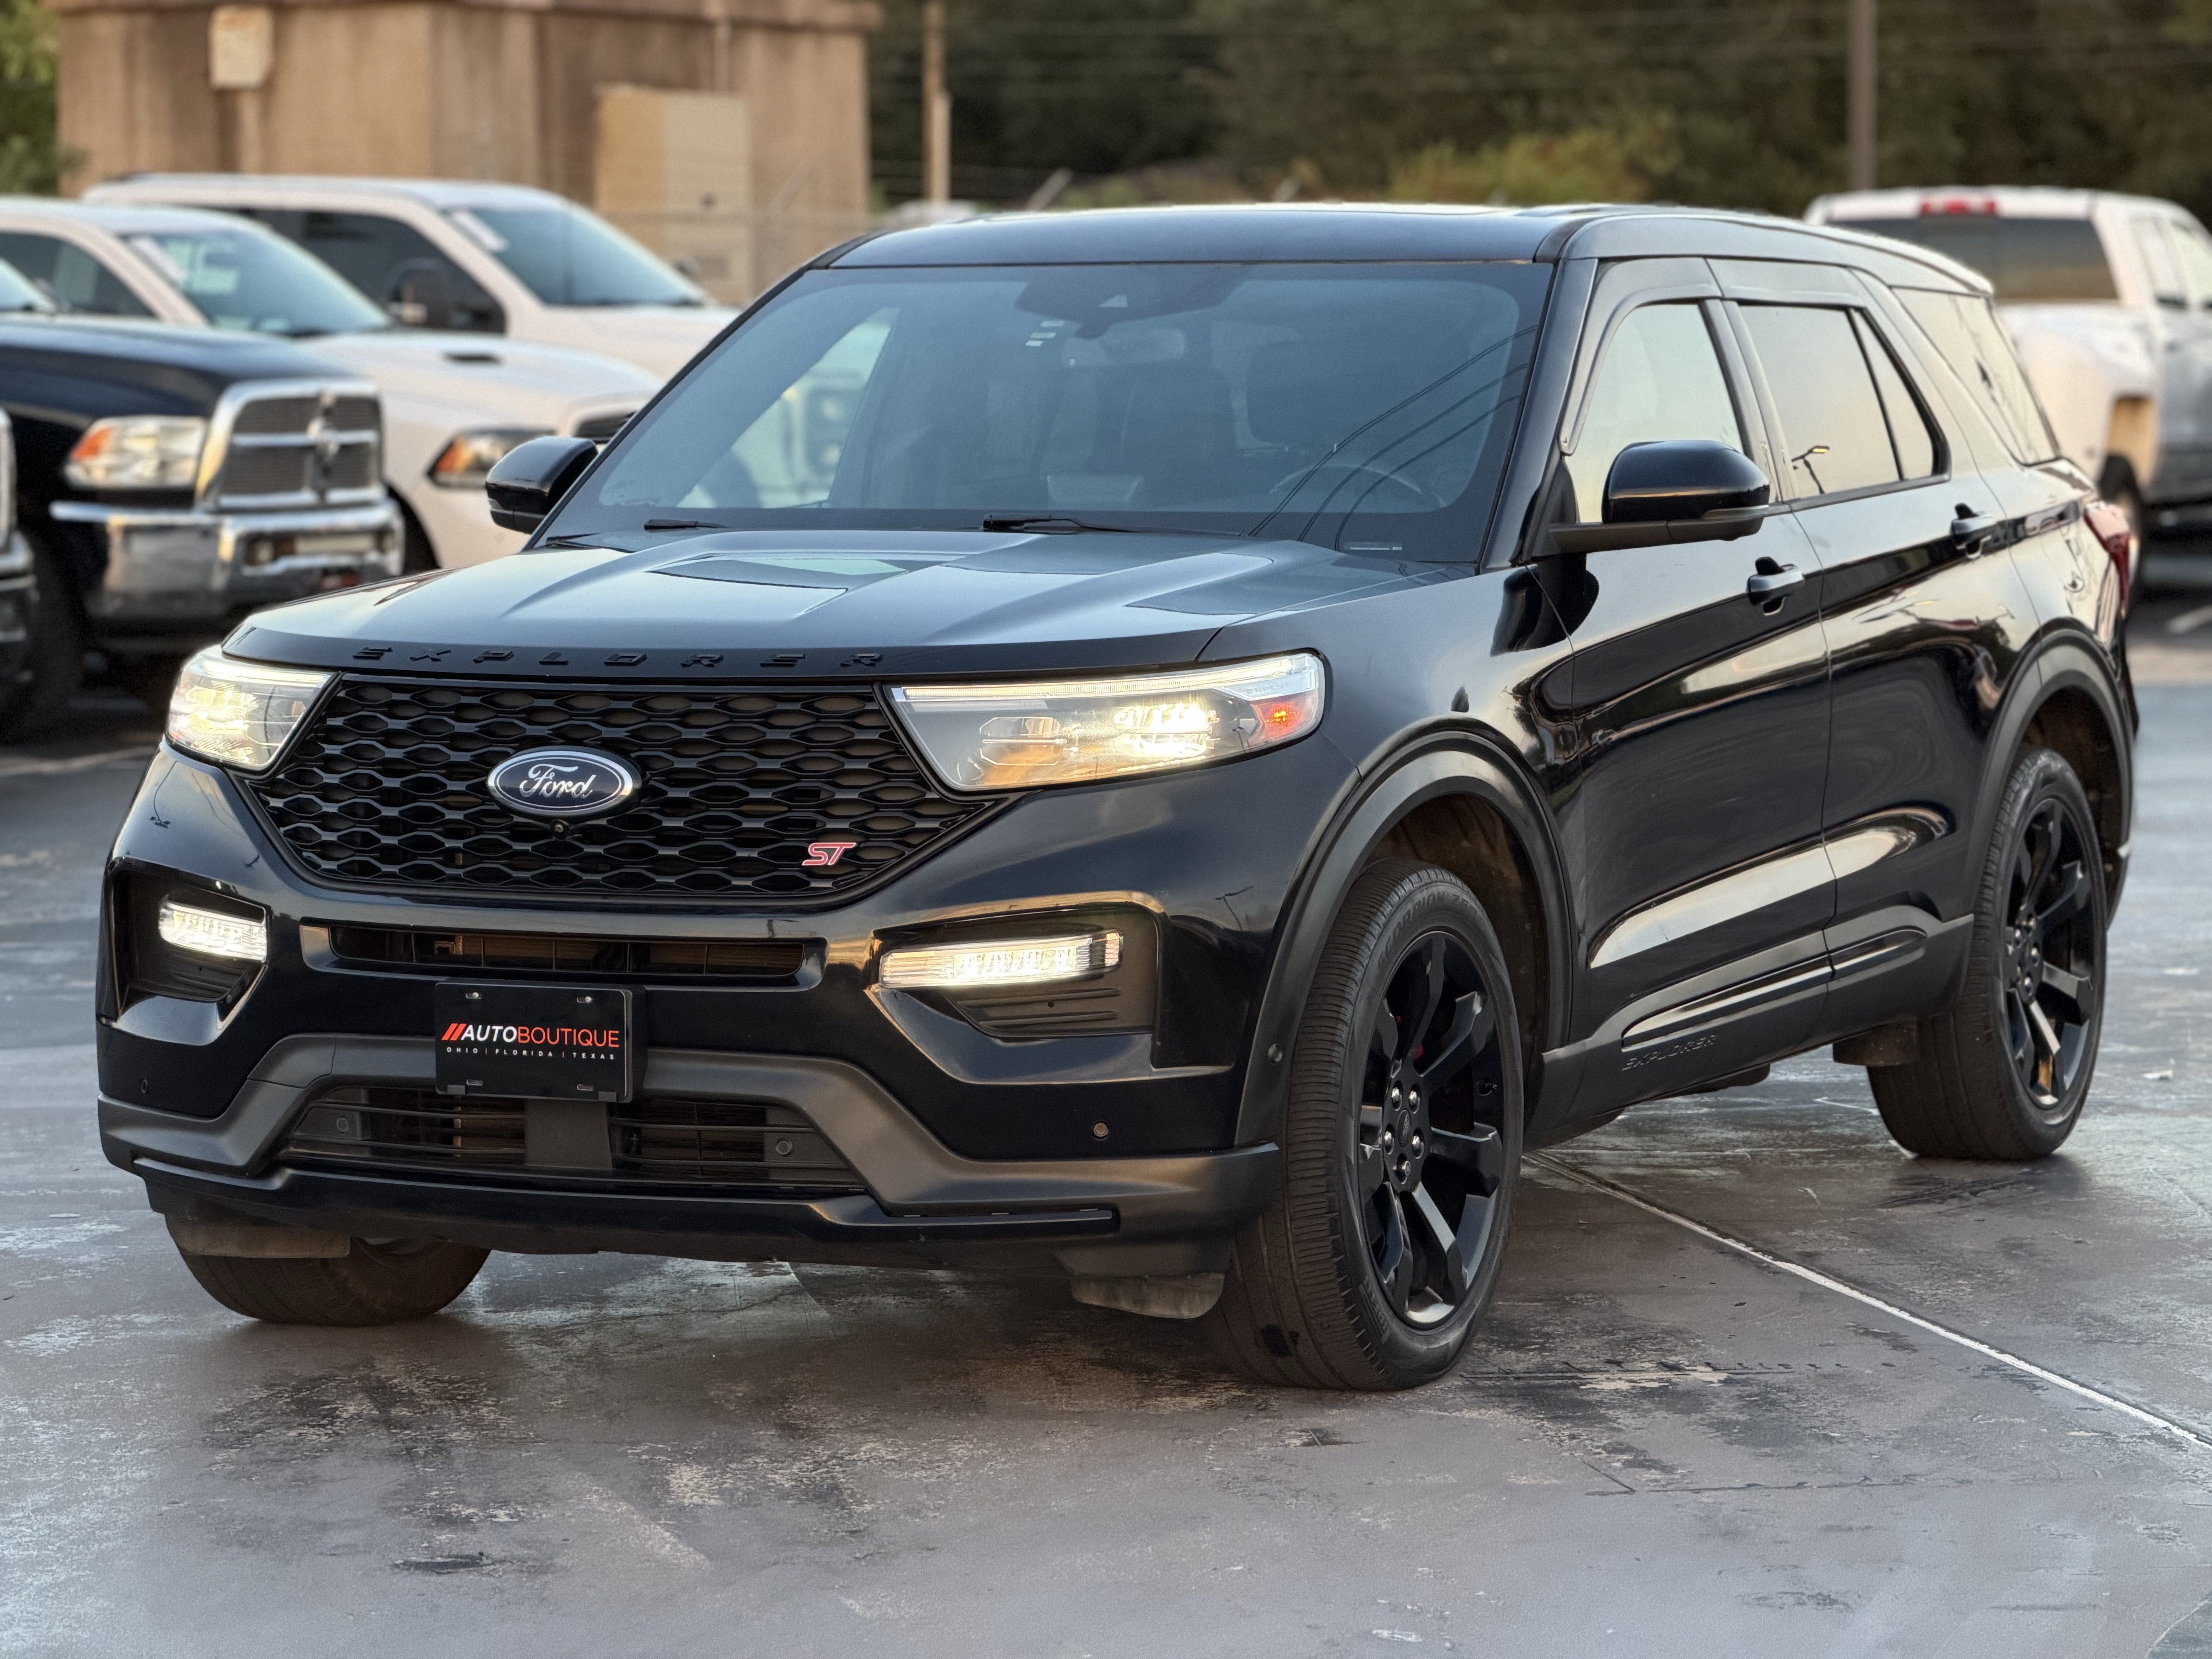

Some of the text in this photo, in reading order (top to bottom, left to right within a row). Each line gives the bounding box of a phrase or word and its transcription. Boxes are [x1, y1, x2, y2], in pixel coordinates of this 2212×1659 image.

[352, 647, 884, 667] EXPLORER
[519, 763, 596, 799] Ford
[802, 842, 857, 866] ST
[1377, 890, 1444, 968] SCORPION
[461, 1024, 620, 1047] AUTOBOUTIQUE
[495, 1049, 553, 1057] FLORIDA
[1622, 1034, 1717, 1070] EXPLORER
